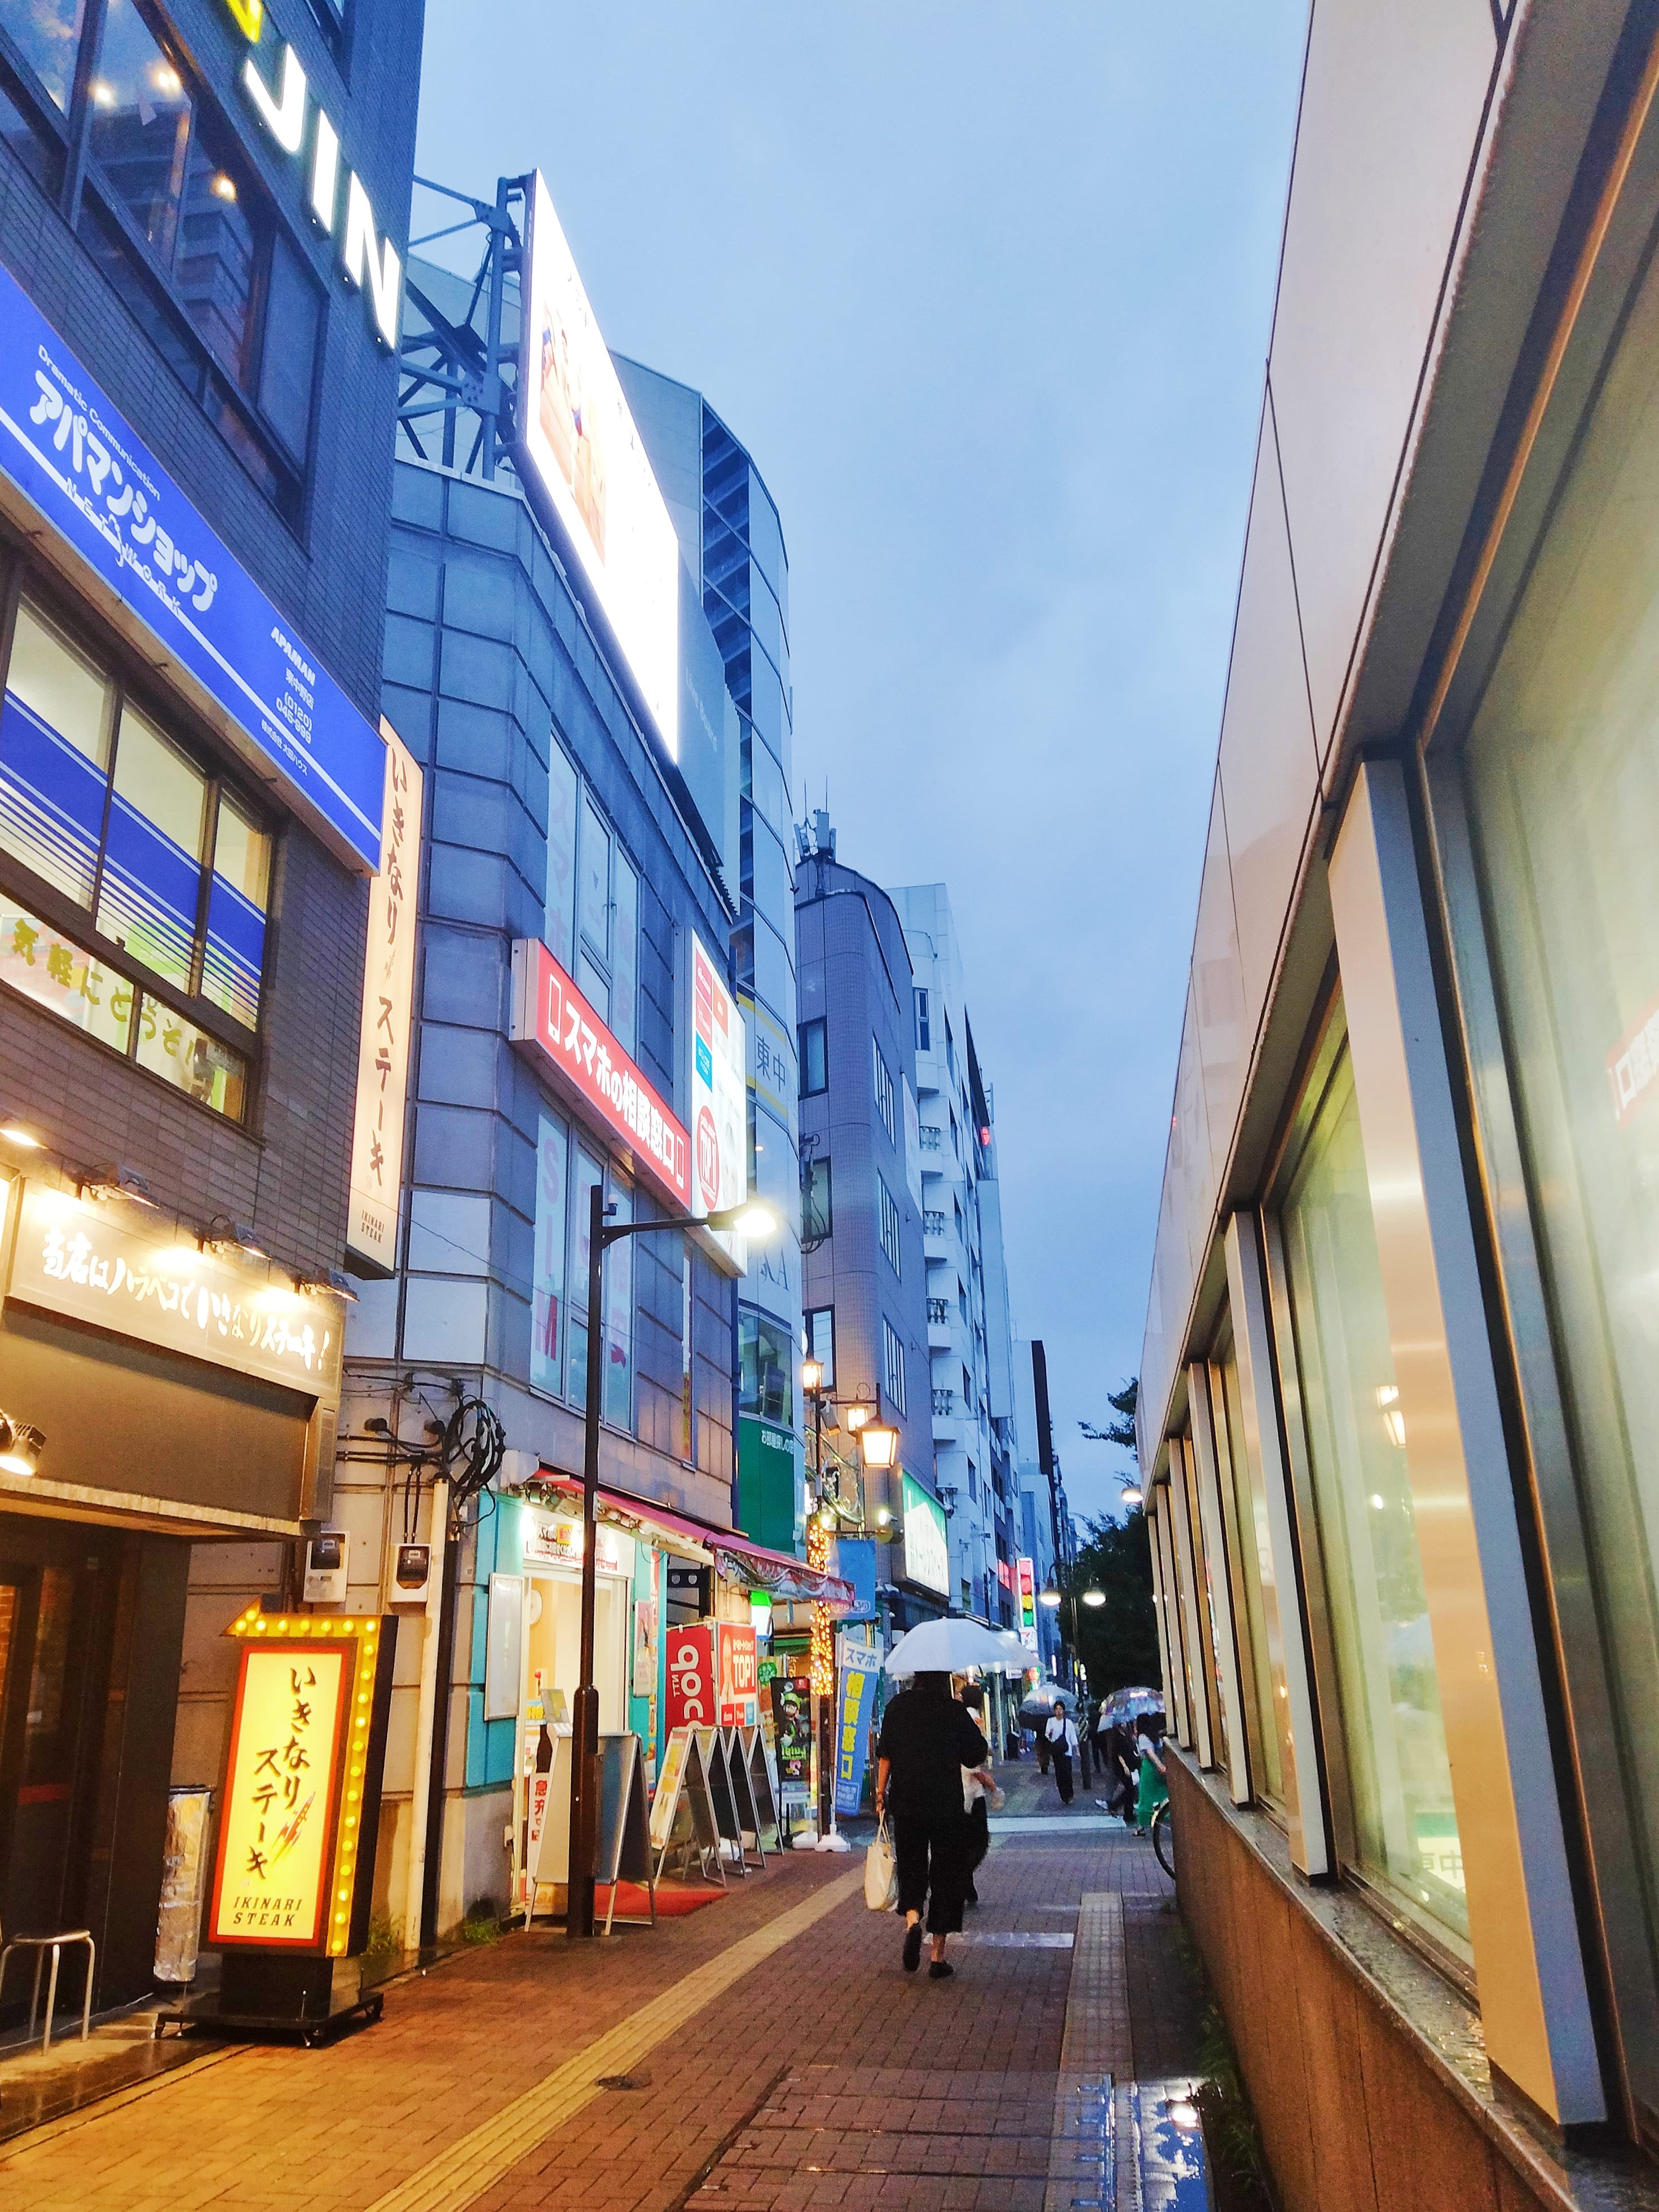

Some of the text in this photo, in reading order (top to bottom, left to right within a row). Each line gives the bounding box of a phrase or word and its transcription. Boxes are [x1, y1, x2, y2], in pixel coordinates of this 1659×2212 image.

[38, 344, 161, 501] Dramatic Communication
[30, 369, 218, 612] アパマンショップ
[271, 626, 316, 687] APAMAN
[285, 668, 314, 710] 東中野店
[284, 691, 312, 731] (0120)
[370, 996, 394, 1186] ステーキ
[564, 999, 675, 1177] スマホの相談窓口
[360, 1221, 383, 1244] STEAK
[361, 1209, 385, 1233] IKINARI
[733, 1654, 755, 1688] TOP1
[846, 1647, 877, 1667] スマホ
[282, 1665, 317, 1811] いきなり
[246, 1747, 280, 1880] ステーキ
[232, 1896, 304, 1911] IKINARI
[232, 1912, 296, 1927] STEAK
